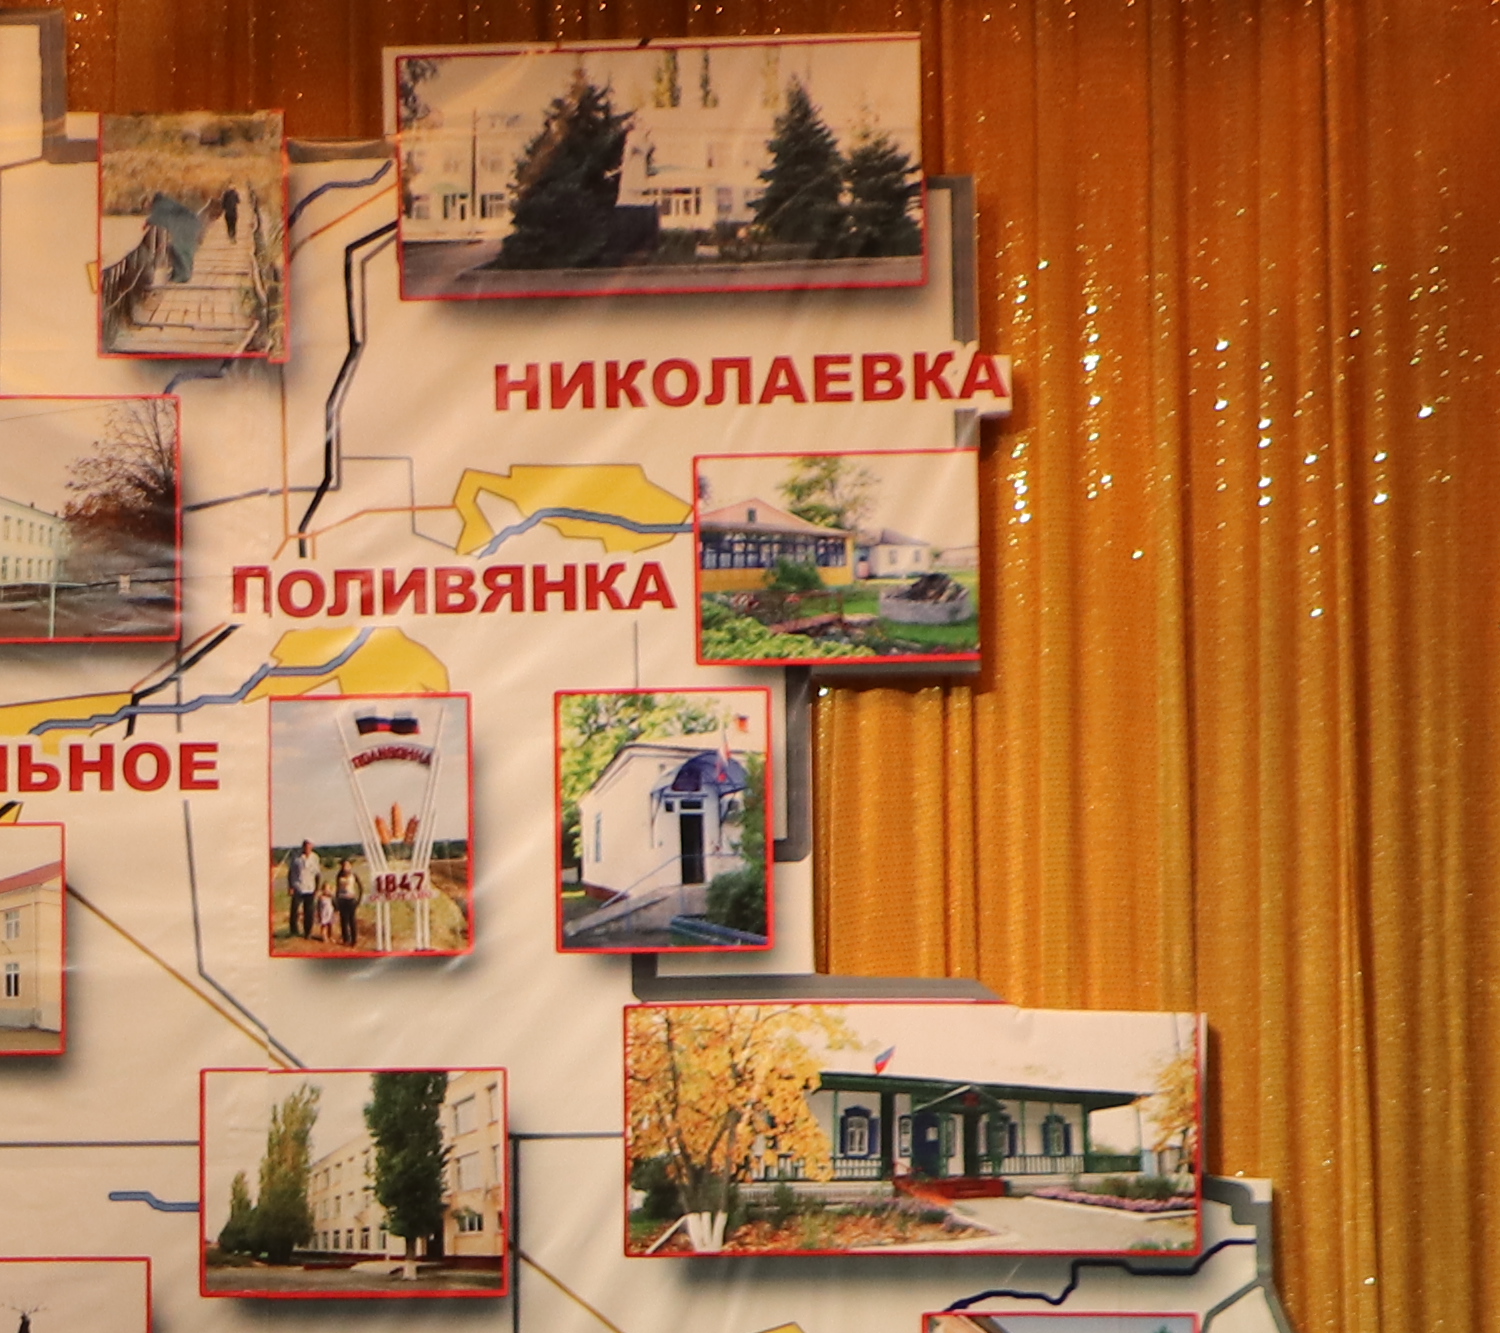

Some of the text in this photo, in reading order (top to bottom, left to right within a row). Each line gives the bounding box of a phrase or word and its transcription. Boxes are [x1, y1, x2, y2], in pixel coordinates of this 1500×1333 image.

[493, 349, 1010, 412] НИКОЛАЕВКА
[231, 561, 677, 619] ПОЛИВЯНКА
[375, 871, 425, 894] 1847
